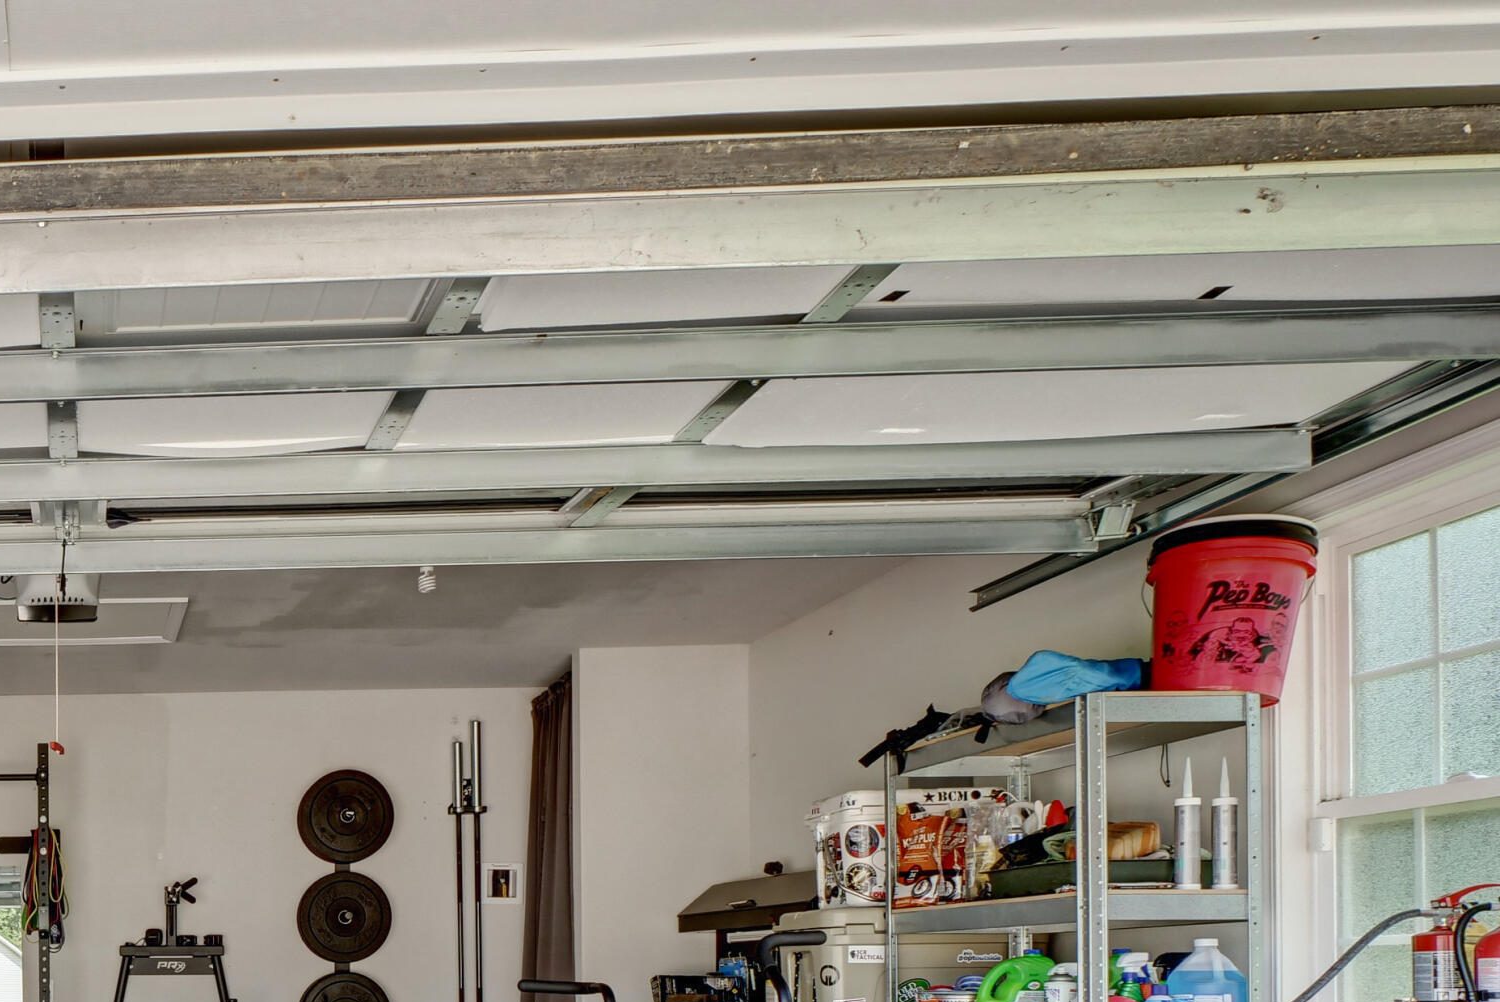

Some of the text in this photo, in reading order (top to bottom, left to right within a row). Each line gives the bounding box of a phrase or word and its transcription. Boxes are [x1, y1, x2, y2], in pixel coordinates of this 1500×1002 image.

[1198, 580, 1291, 621] Pep Boys
[938, 790, 968, 801] BCM
